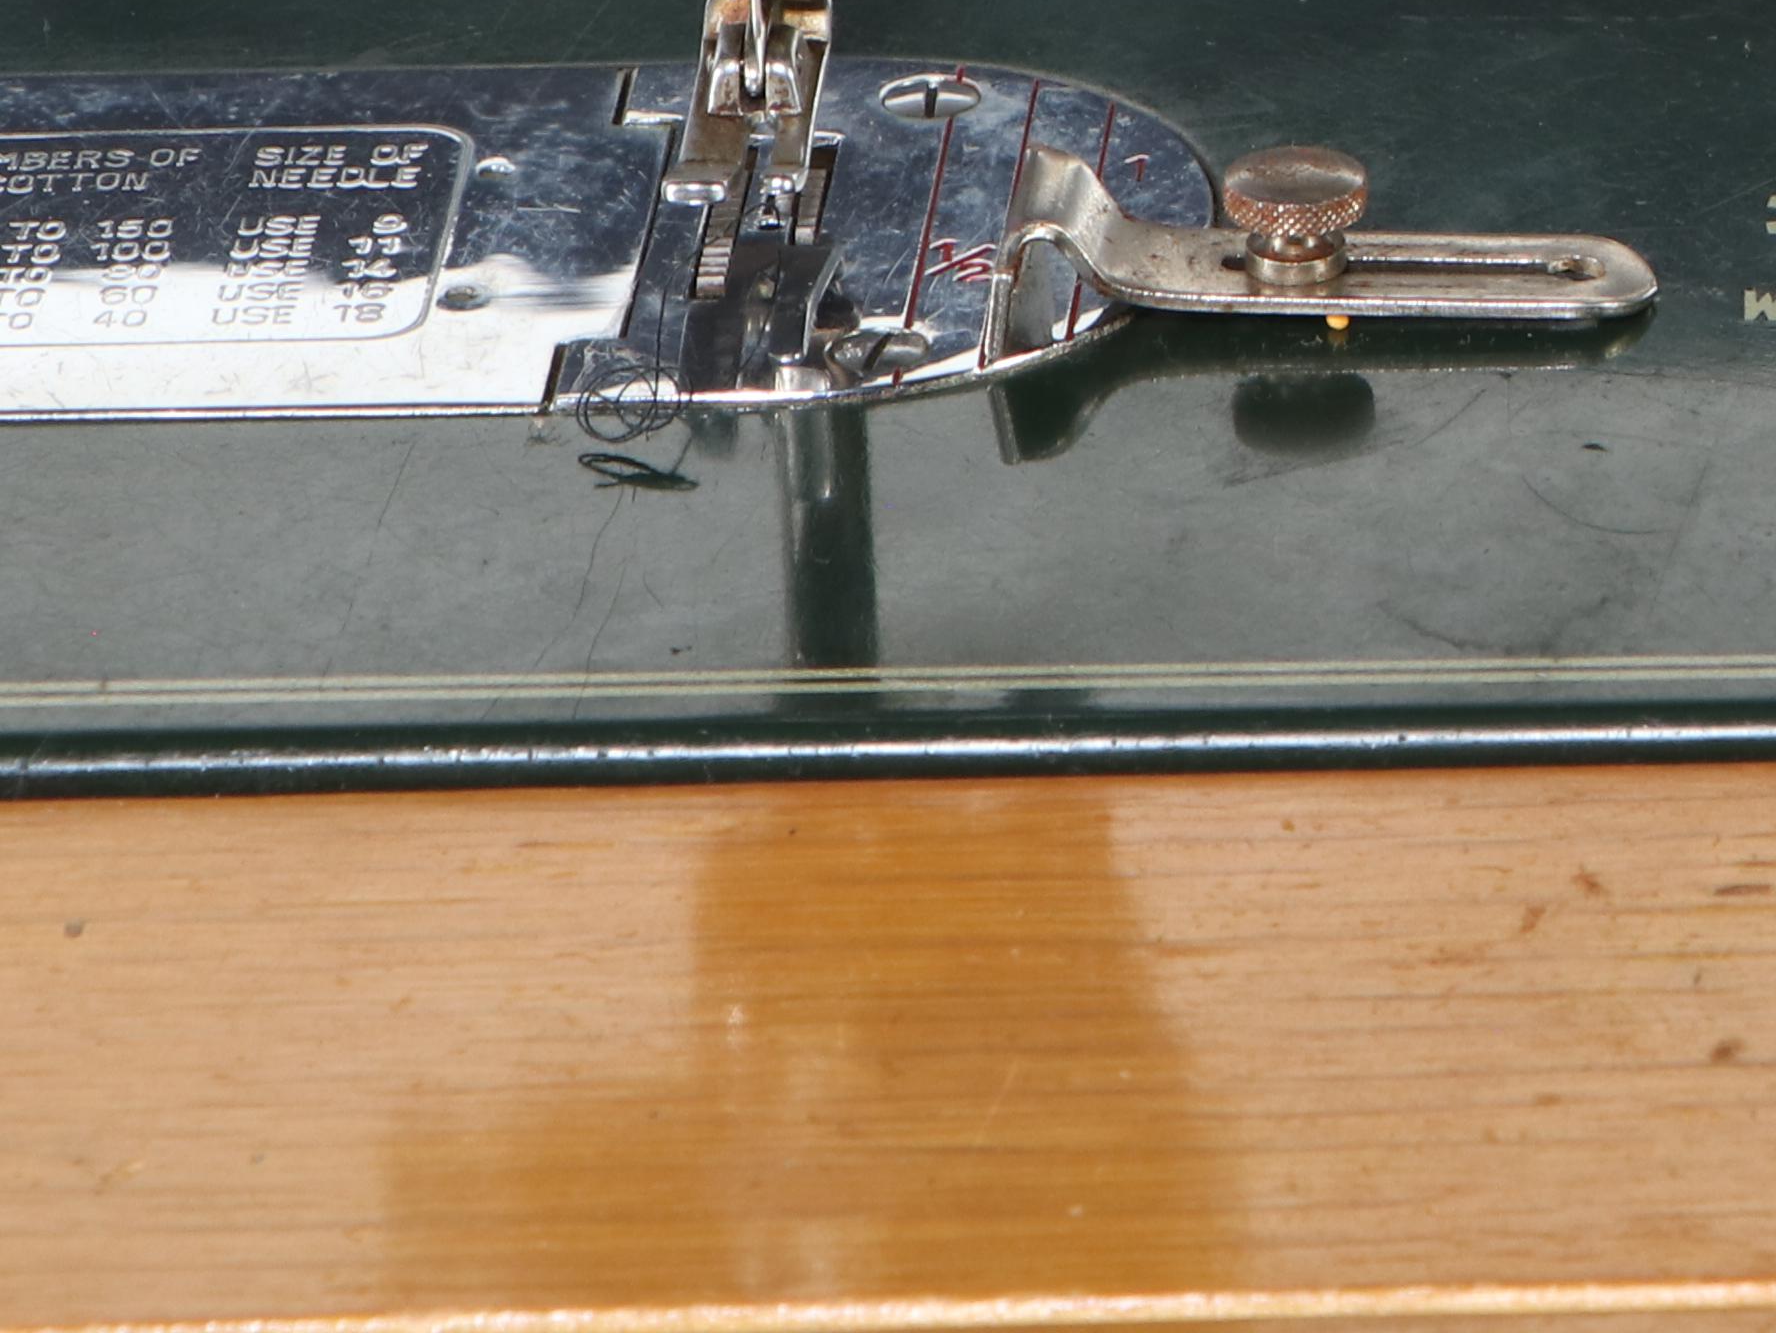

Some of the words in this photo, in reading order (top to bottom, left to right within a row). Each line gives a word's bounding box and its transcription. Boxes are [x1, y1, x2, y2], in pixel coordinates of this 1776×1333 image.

[150, 148, 202, 168] OF
[254, 144, 347, 166] SIZE
[370, 143, 429, 165] OF
[248, 166, 422, 189] NEEDLE
[8, 219, 67, 242] TO
[97, 217, 174, 239] 150
[237, 215, 321, 236] USE
[1, 242, 62, 264] TO
[90, 241, 171, 263] 100
[229, 236, 315, 260] USE
[348, 235, 401, 255] 11
[225, 259, 309, 277] USE
[99, 285, 159, 306] 60
[218, 283, 304, 301] USE
[93, 309, 147, 328] 40
[211, 304, 296, 324] USE
[333, 302, 387, 323] 18
